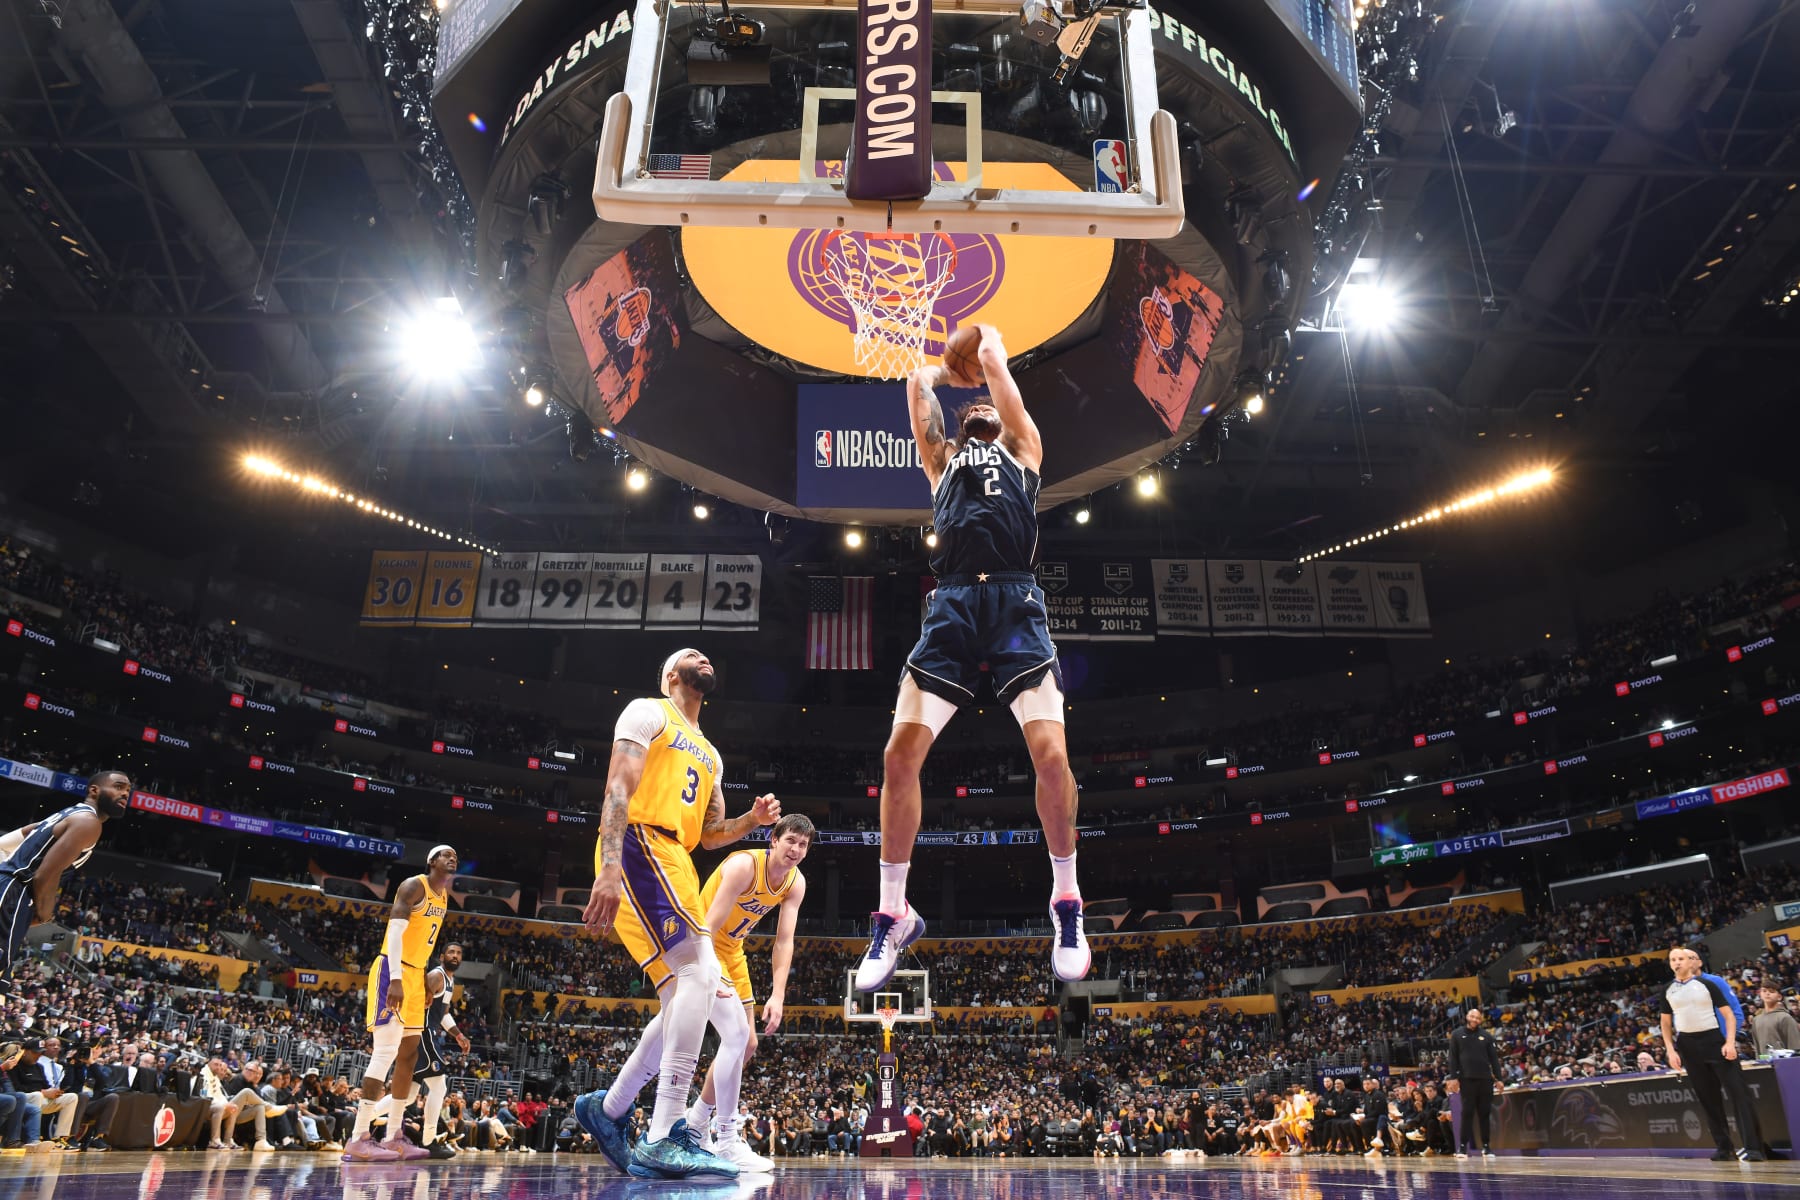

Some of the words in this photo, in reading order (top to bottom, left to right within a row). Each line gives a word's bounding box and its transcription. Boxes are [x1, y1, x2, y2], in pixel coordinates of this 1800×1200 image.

[564, 9, 634, 72] SNA
[1101, 183, 1117, 193] NBA
[983, 466, 1002, 497] 2
[433, 560, 473, 569] DIONNE
[541, 561, 588, 571] GRETZKY
[594, 561, 646, 572] ROBITAILLE
[660, 563, 694, 573] BLAKE
[715, 563, 754, 574] BROWN
[370, 577, 413, 607] 30
[432, 578, 465, 607] 16
[487, 579, 521, 608] 18
[540, 579, 583, 608] 99
[597, 579, 638, 609] 20
[663, 580, 685, 610] 4
[713, 581, 753, 611] 23
[1065, 596, 1084, 605] CUP
[1090, 597, 1129, 606] STANLEY
[1130, 597, 1149, 606] CUP
[1161, 602, 1203, 611] CHAMPIONS
[1216, 602, 1260, 611] CHAMPIONS
[1090, 607, 1149, 617] CHAMPIONS
[1167, 612, 1199, 622] 2013-14
[1224, 613, 1255, 622] 2011-12
[1101, 619, 1142, 631] 2011-12
[24, 628, 56, 647] TOYOTA
[1742, 636, 1775, 653] TOYOTA
[140, 667, 171, 684] TOYOTA
[1630, 675, 1662, 690] TOYOTA
[245, 700, 276, 713] TOYOTA
[1778, 693, 1800, 707] TOYO
[41, 702, 75, 718] TOYOTA
[1527, 706, 1557, 719] TOYOTA
[349, 724, 377, 737] TOYOTA
[1427, 730, 1456, 742] TOYOTA
[1664, 726, 1699, 741] TOYOTA
[159, 734, 190, 749] TOYOTA
[446, 745, 474, 757] TOYOTA
[668, 730, 715, 774] LAKERS
[1331, 751, 1360, 761] TOYOTA
[265, 760, 296, 774] TOYOTA
[541, 761, 567, 772] TOYOTA
[1557, 754, 1588, 768] TOYOTA
[13, 766, 49, 784] Health
[1238, 765, 1265, 774] TOYOTA
[681, 765, 700, 805] 3
[723, 782, 749, 790] TOYOTA
[1147, 776, 1173, 784] TOYOTA
[1455, 778, 1485, 790] TOYOTA
[1714, 772, 1785, 799] TOSHIBA
[368, 782, 395, 795] TOYOTA
[135, 794, 200, 820] TOSHIBA
[465, 800, 493, 810] TOYOTA
[1358, 798, 1387, 809] TOYOTA
[1676, 794, 1709, 808] ULTRA
[559, 814, 586, 824] TOYOTA
[1263, 811, 1290, 821] TOYOTA
[1171, 823, 1198, 831] TOYOTA
[309, 830, 337, 844] ULTRA
[830, 834, 855, 843] Lakers
[917, 834, 954, 844] Mavericks
[963, 833, 978, 845] 43
[1081, 830, 1106, 838] TOYOTA
[358, 839, 400, 856] DELTA
[1453, 836, 1497, 852] DELTA
[1401, 847, 1429, 861] Sprite
[427, 923, 438, 945] 2
[301, 974, 316, 984] 114
